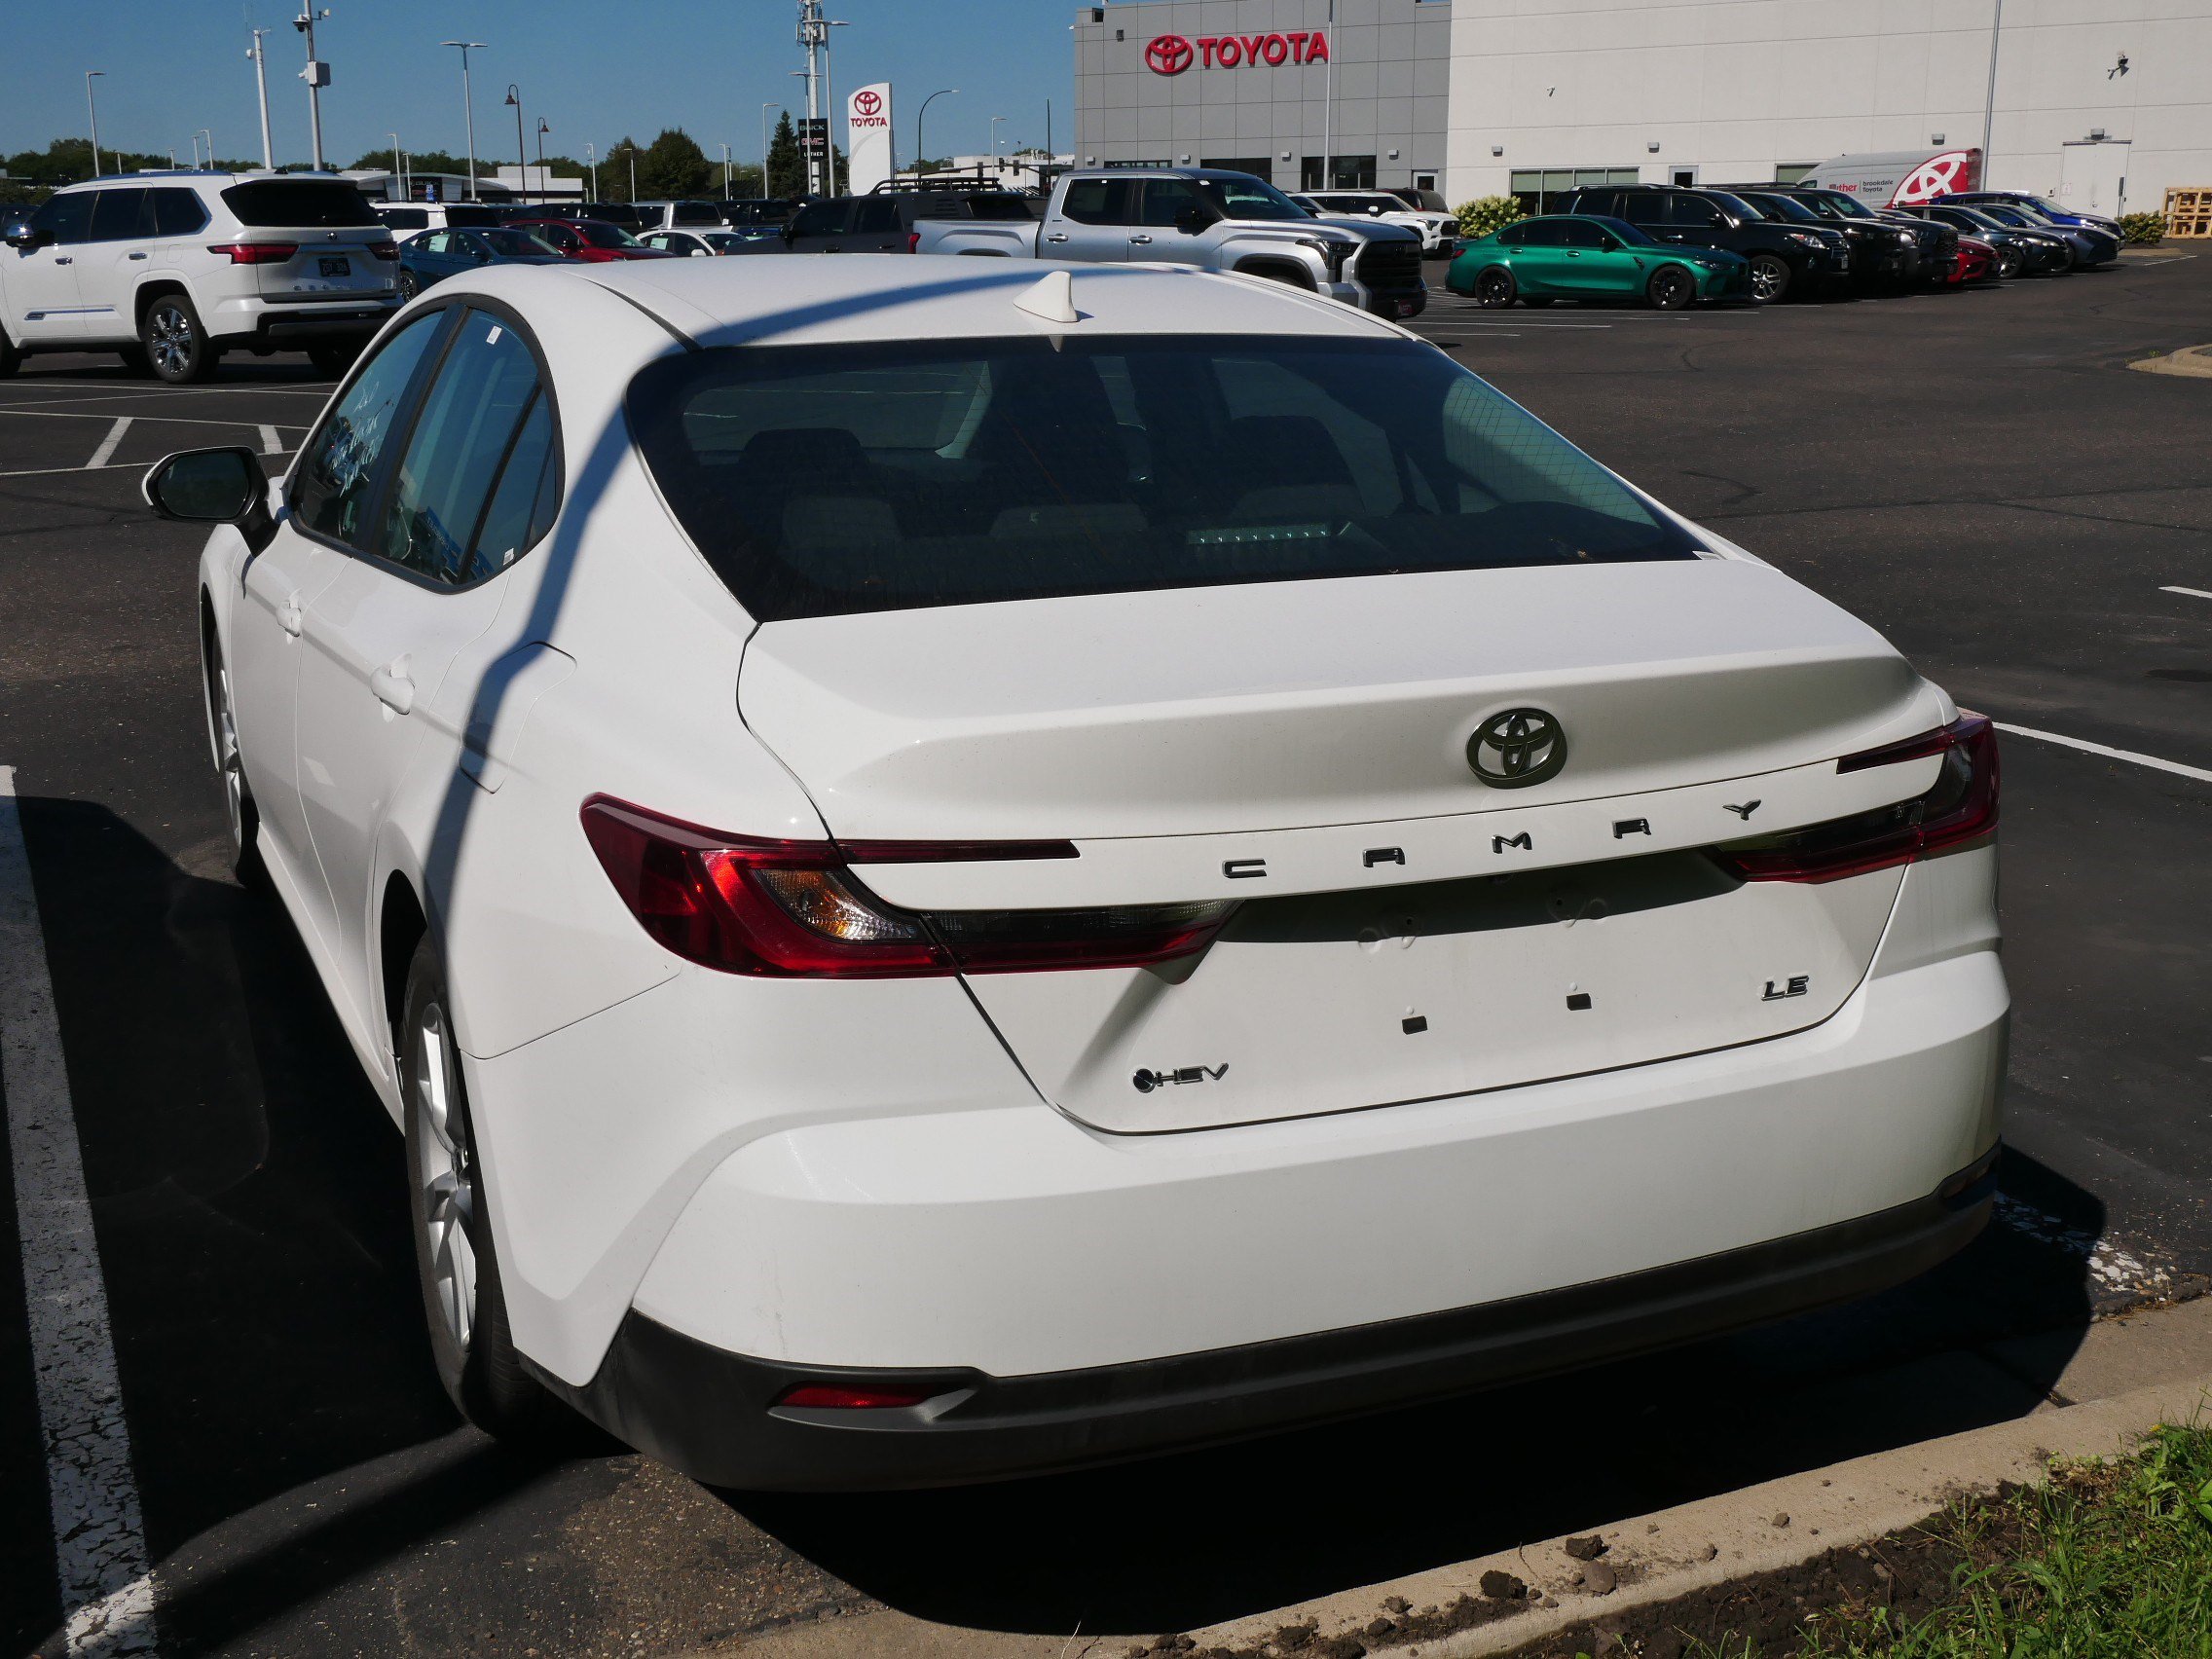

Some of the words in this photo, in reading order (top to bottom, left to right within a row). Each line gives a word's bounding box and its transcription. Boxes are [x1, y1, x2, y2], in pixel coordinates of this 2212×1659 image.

[1197, 32, 1331, 68] TOYOTA
[850, 117, 888, 128] TOYOTA
[1222, 798, 1762, 879] CAMRY
[1760, 975, 1810, 1002] LE
[1156, 1062, 1230, 1088] HEV
